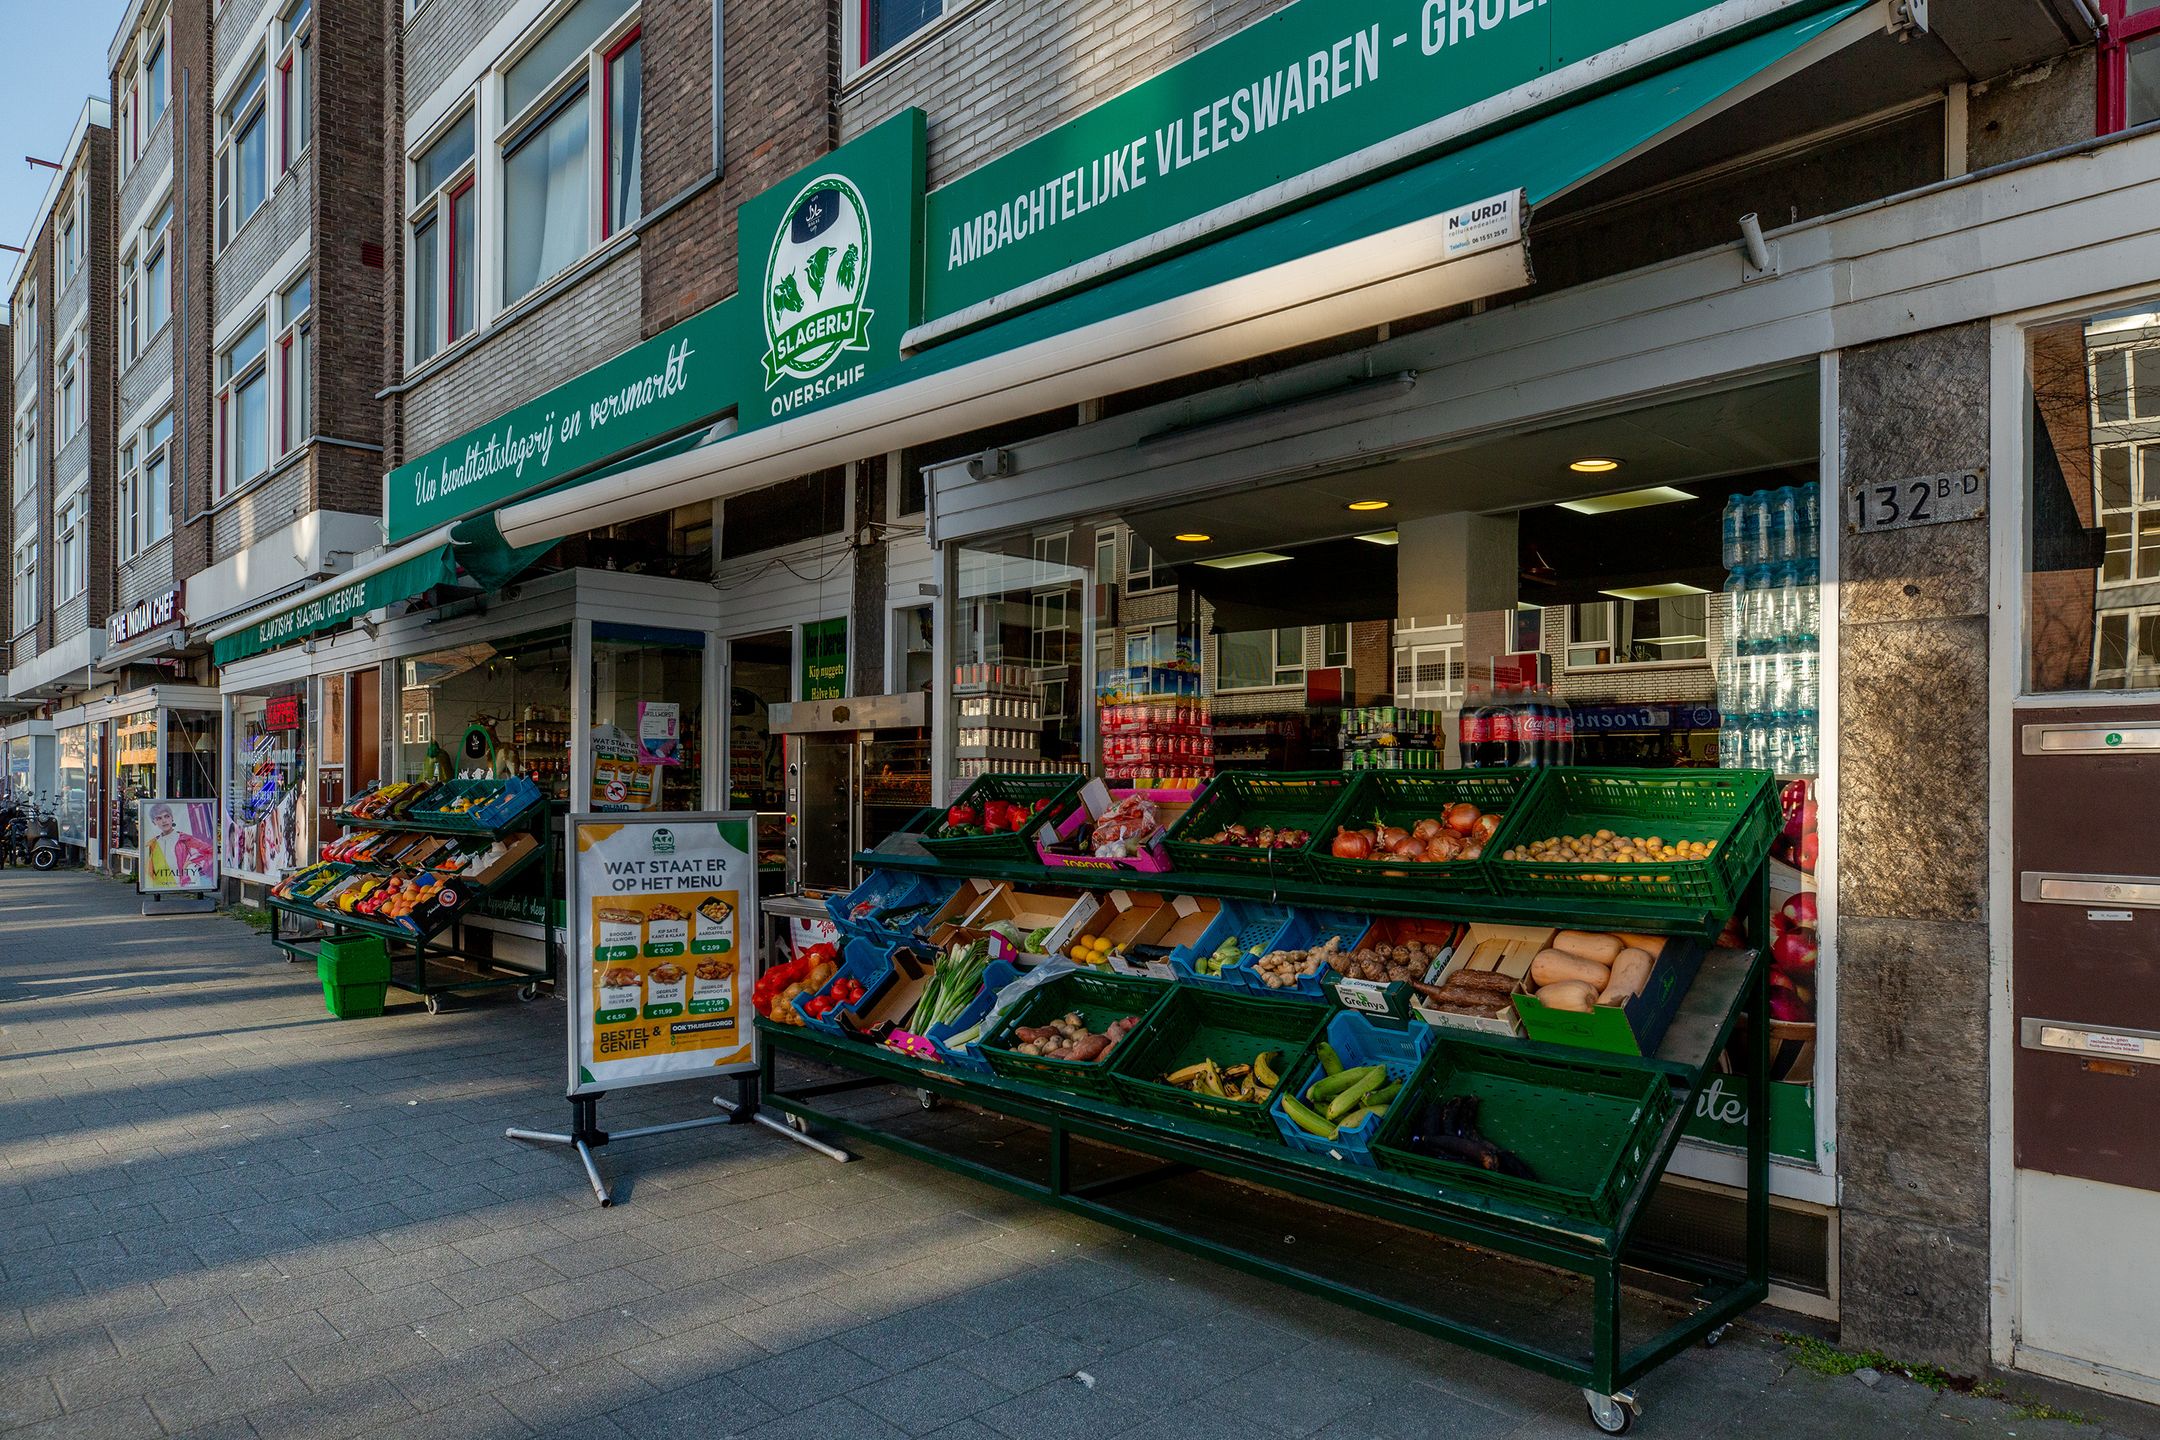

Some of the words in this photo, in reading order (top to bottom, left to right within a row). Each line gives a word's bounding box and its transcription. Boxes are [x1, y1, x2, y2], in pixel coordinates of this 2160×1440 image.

[948, 136, 1147, 271] AMBACHTELIJKE
[1155, 23, 1379, 178] VLEESWAREN
[777, 310, 853, 360] SLAGERIJ
[414, 471, 437, 506] Uw
[440, 416, 555, 497] kwaliteitsslagerij
[560, 410, 582, 444] en
[590, 337, 696, 430] versmarkt
[112, 614, 126, 642] THE
[127, 602, 152, 637] INDIAN
[154, 590, 174, 625] CHEF
[809, 665, 820, 680] Kip
[821, 664, 844, 678] nuggets
[812, 688, 828, 700] Halve
[829, 686, 839, 698] kip
[604, 861, 645, 874] WAT
[650, 860, 702, 873] STAAT
[707, 859, 726, 871] ER
[612, 878, 636, 891] OP
[642, 877, 673, 890] HET
[678, 875, 722, 888] MENU
[1345, 997, 1385, 1010] Greenya
[688, 1020, 733, 1030] THUISBEZORGD
[601, 1027, 650, 1042] BESTEL
[653, 1026, 661, 1036] &
[600, 1039, 648, 1053] GENIET
